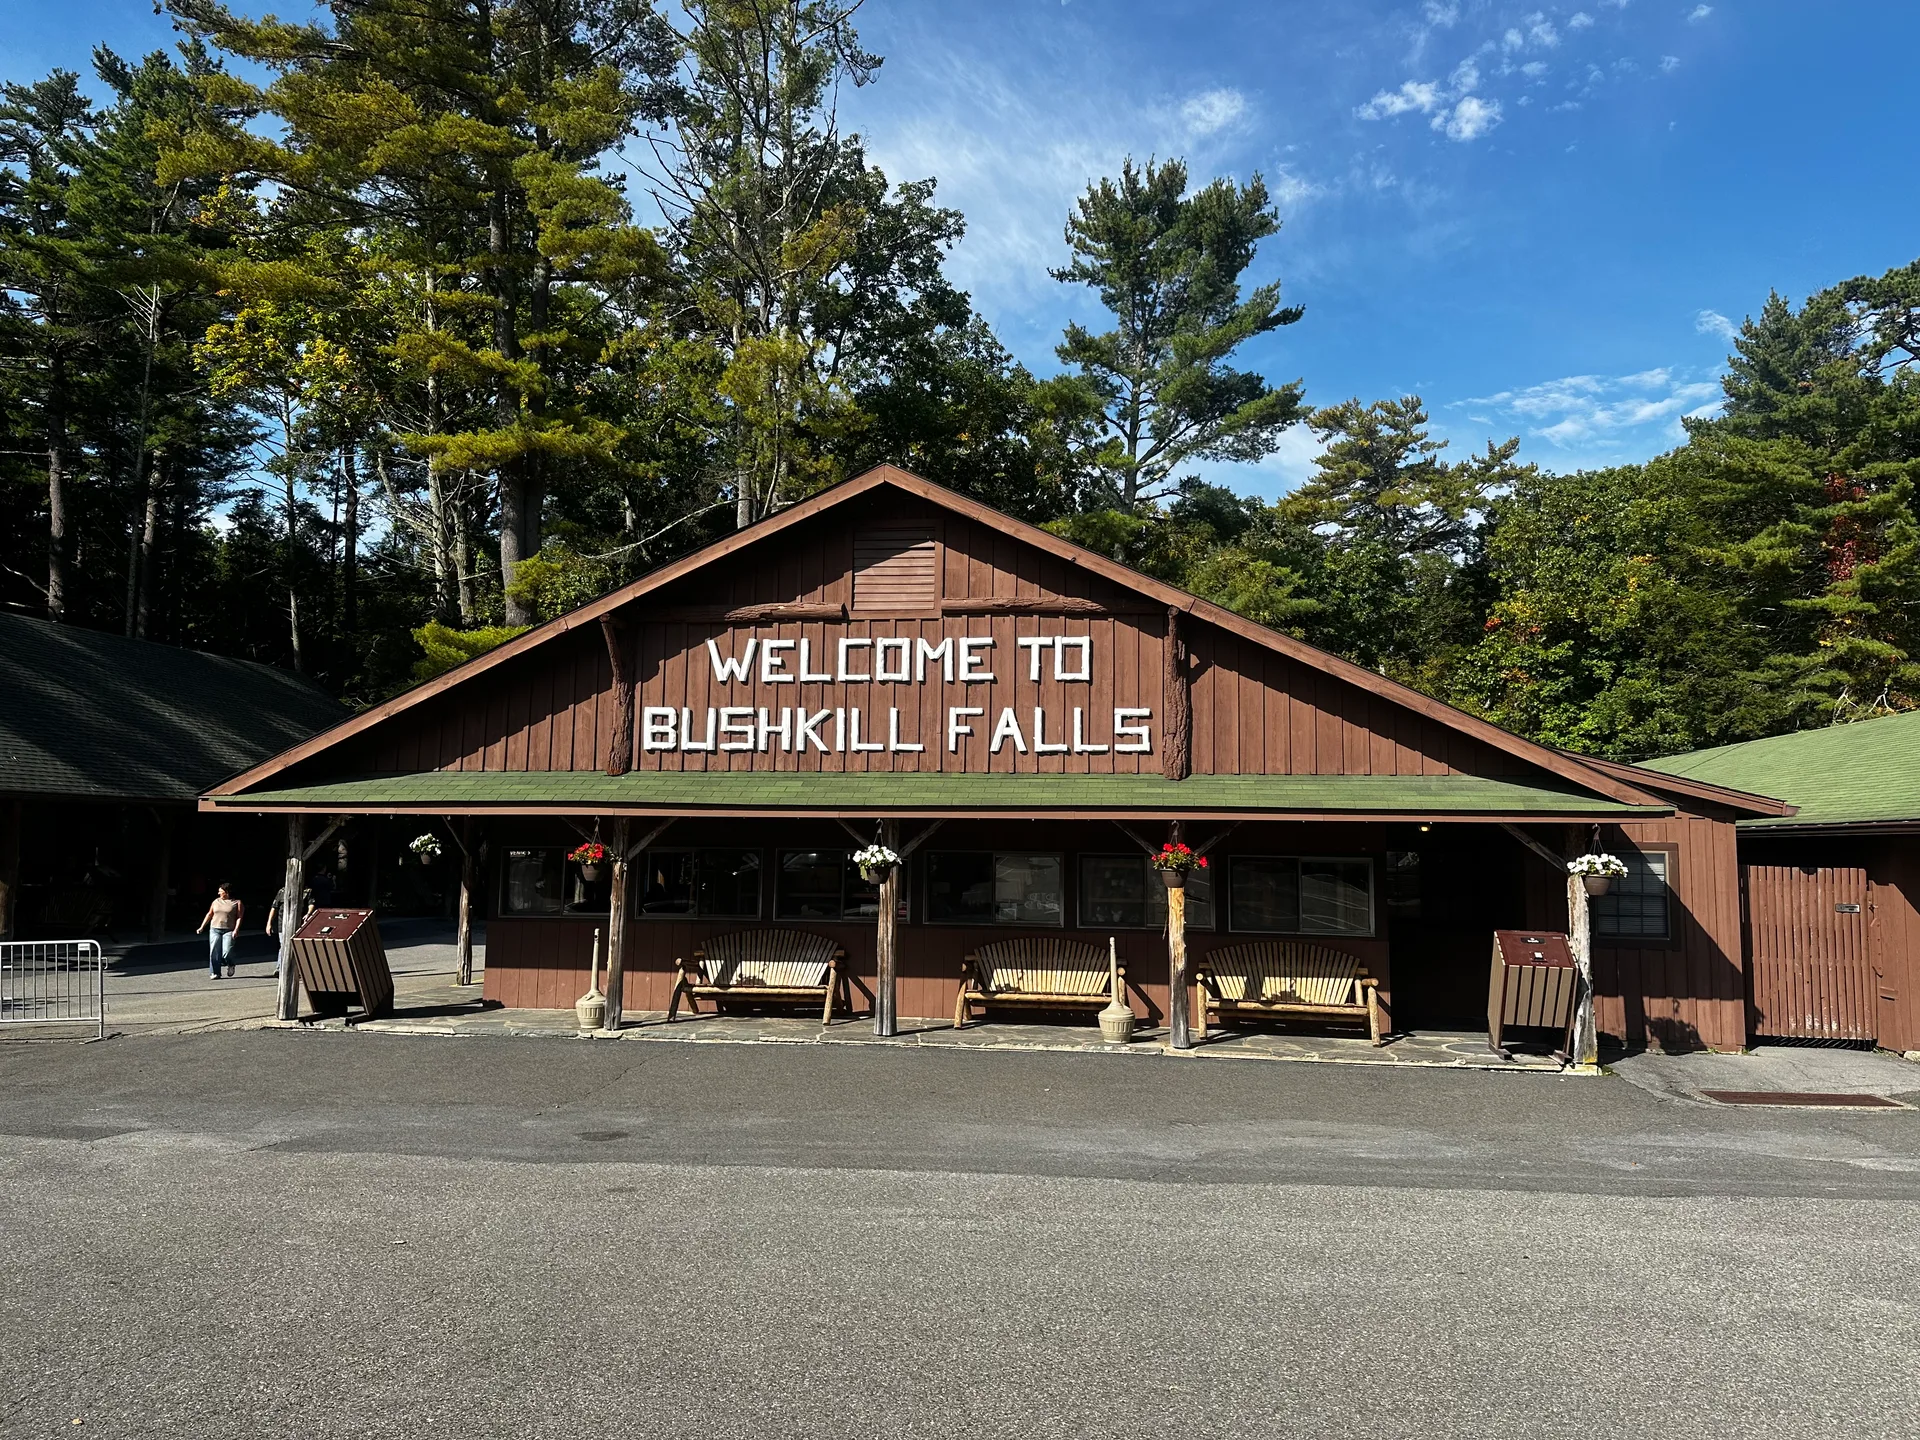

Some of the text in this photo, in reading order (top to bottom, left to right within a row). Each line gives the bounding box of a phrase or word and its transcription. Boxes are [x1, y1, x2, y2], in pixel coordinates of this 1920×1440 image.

[706, 636, 1090, 682] WELCOME TO
[642, 706, 1151, 752] BUSHKILL FALLS
